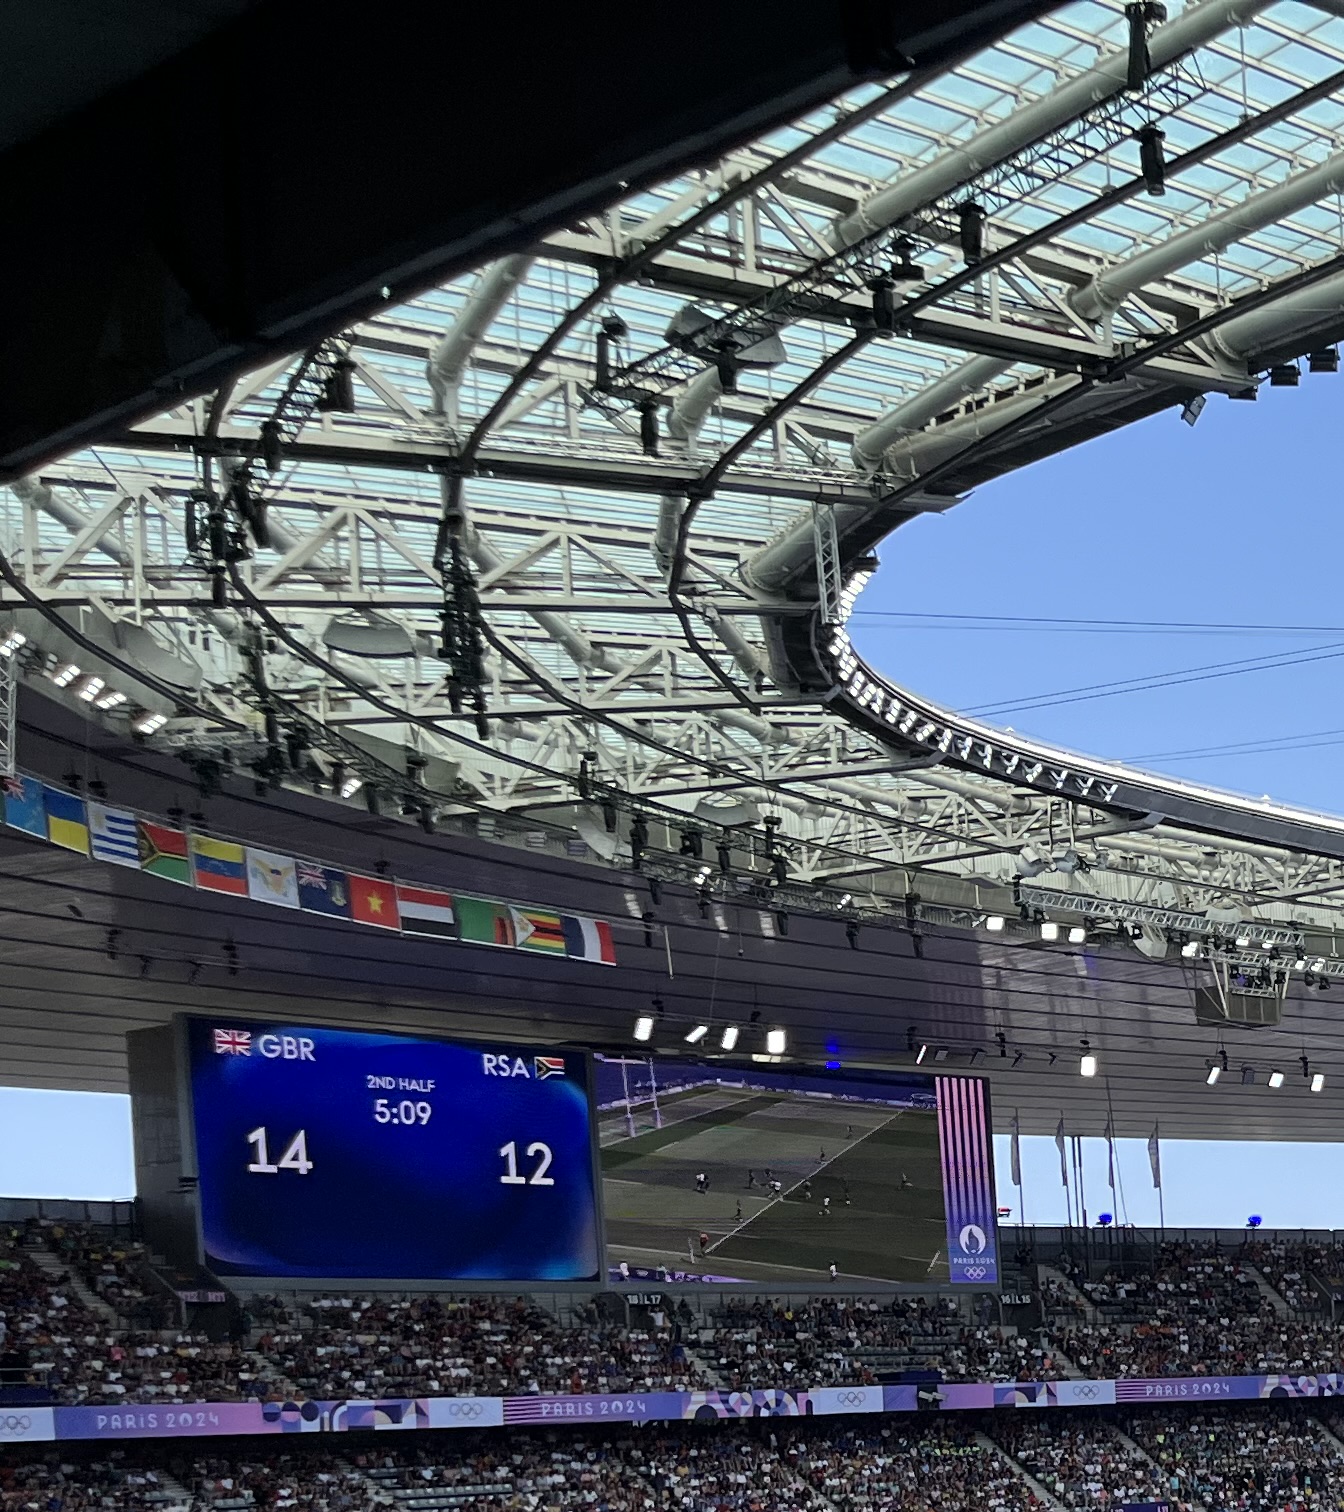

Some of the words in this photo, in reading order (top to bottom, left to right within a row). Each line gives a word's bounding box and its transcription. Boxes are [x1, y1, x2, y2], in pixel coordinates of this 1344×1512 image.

[260, 1034, 316, 1062] GBR
[483, 1053, 530, 1079] RSA
[367, 1075, 396, 1091] 2ND
[398, 1076, 436, 1092] HALF
[374, 1099, 432, 1126] 5:09
[246, 1128, 314, 1175] 14
[499, 1142, 555, 1186] 12
[1193, 1382, 1230, 1395] 2024
[166, 1411, 219, 1428] 2024
[600, 1400, 646, 1415] 2024
